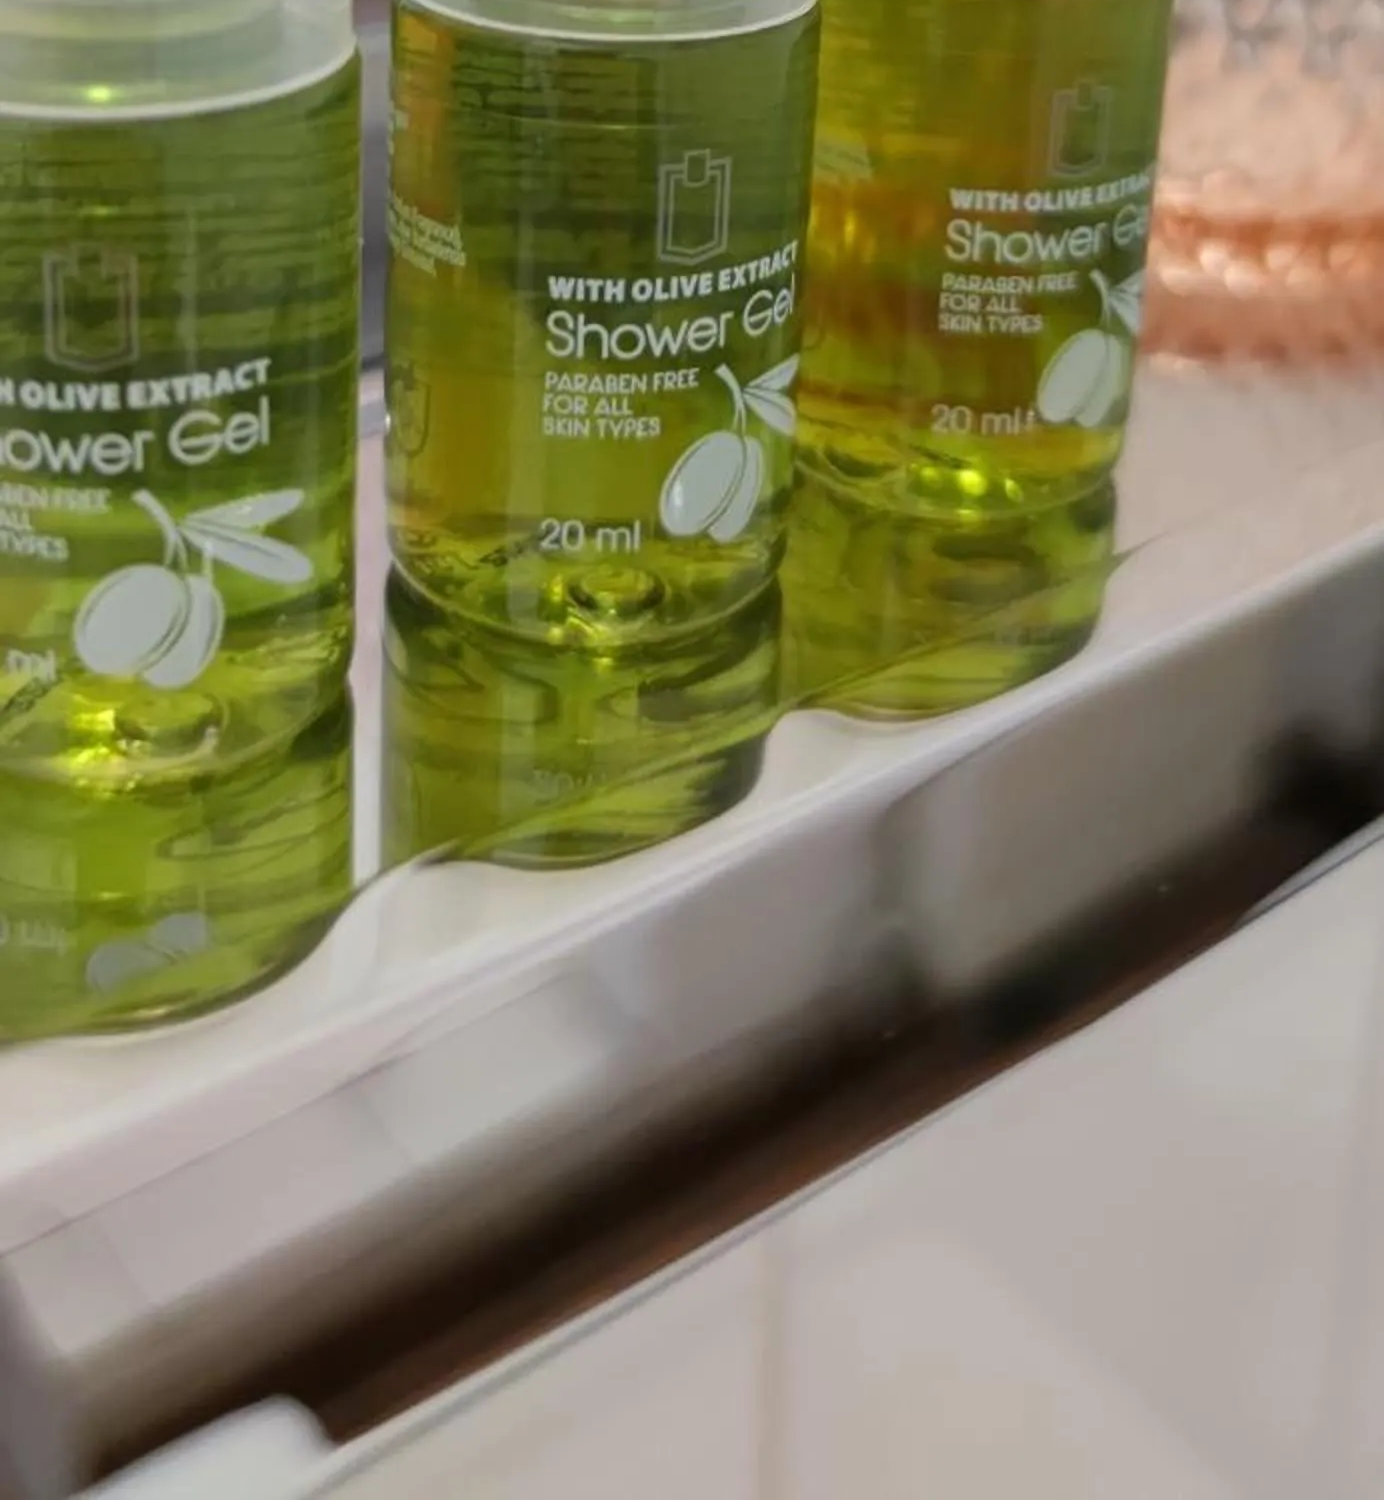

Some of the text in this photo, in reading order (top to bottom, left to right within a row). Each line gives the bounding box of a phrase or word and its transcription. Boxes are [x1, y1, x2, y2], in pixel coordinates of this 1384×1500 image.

[949, 188, 1018, 212] WITH
[1024, 186, 1093, 213] OLIVE
[944, 218, 1108, 265] Shower
[548, 239, 798, 303] WITH OLIVE EXTRACT
[942, 270, 1081, 294] PARABEN FREE
[546, 272, 796, 360] Shower Gel
[940, 292, 1021, 313] FOR ALL
[938, 313, 1044, 335] SKIN TYPES
[19, 381, 120, 411] OLIVE
[126, 357, 272, 410] EXTRACT
[545, 367, 700, 394] PARABEN FREE
[543, 393, 634, 416] FOR ALL
[931, 403, 1021, 436] 20 ml
[0, 394, 271, 475] ower Gel
[543, 415, 661, 439] SKIN TYPES
[539, 517, 641, 553] 20 ml
